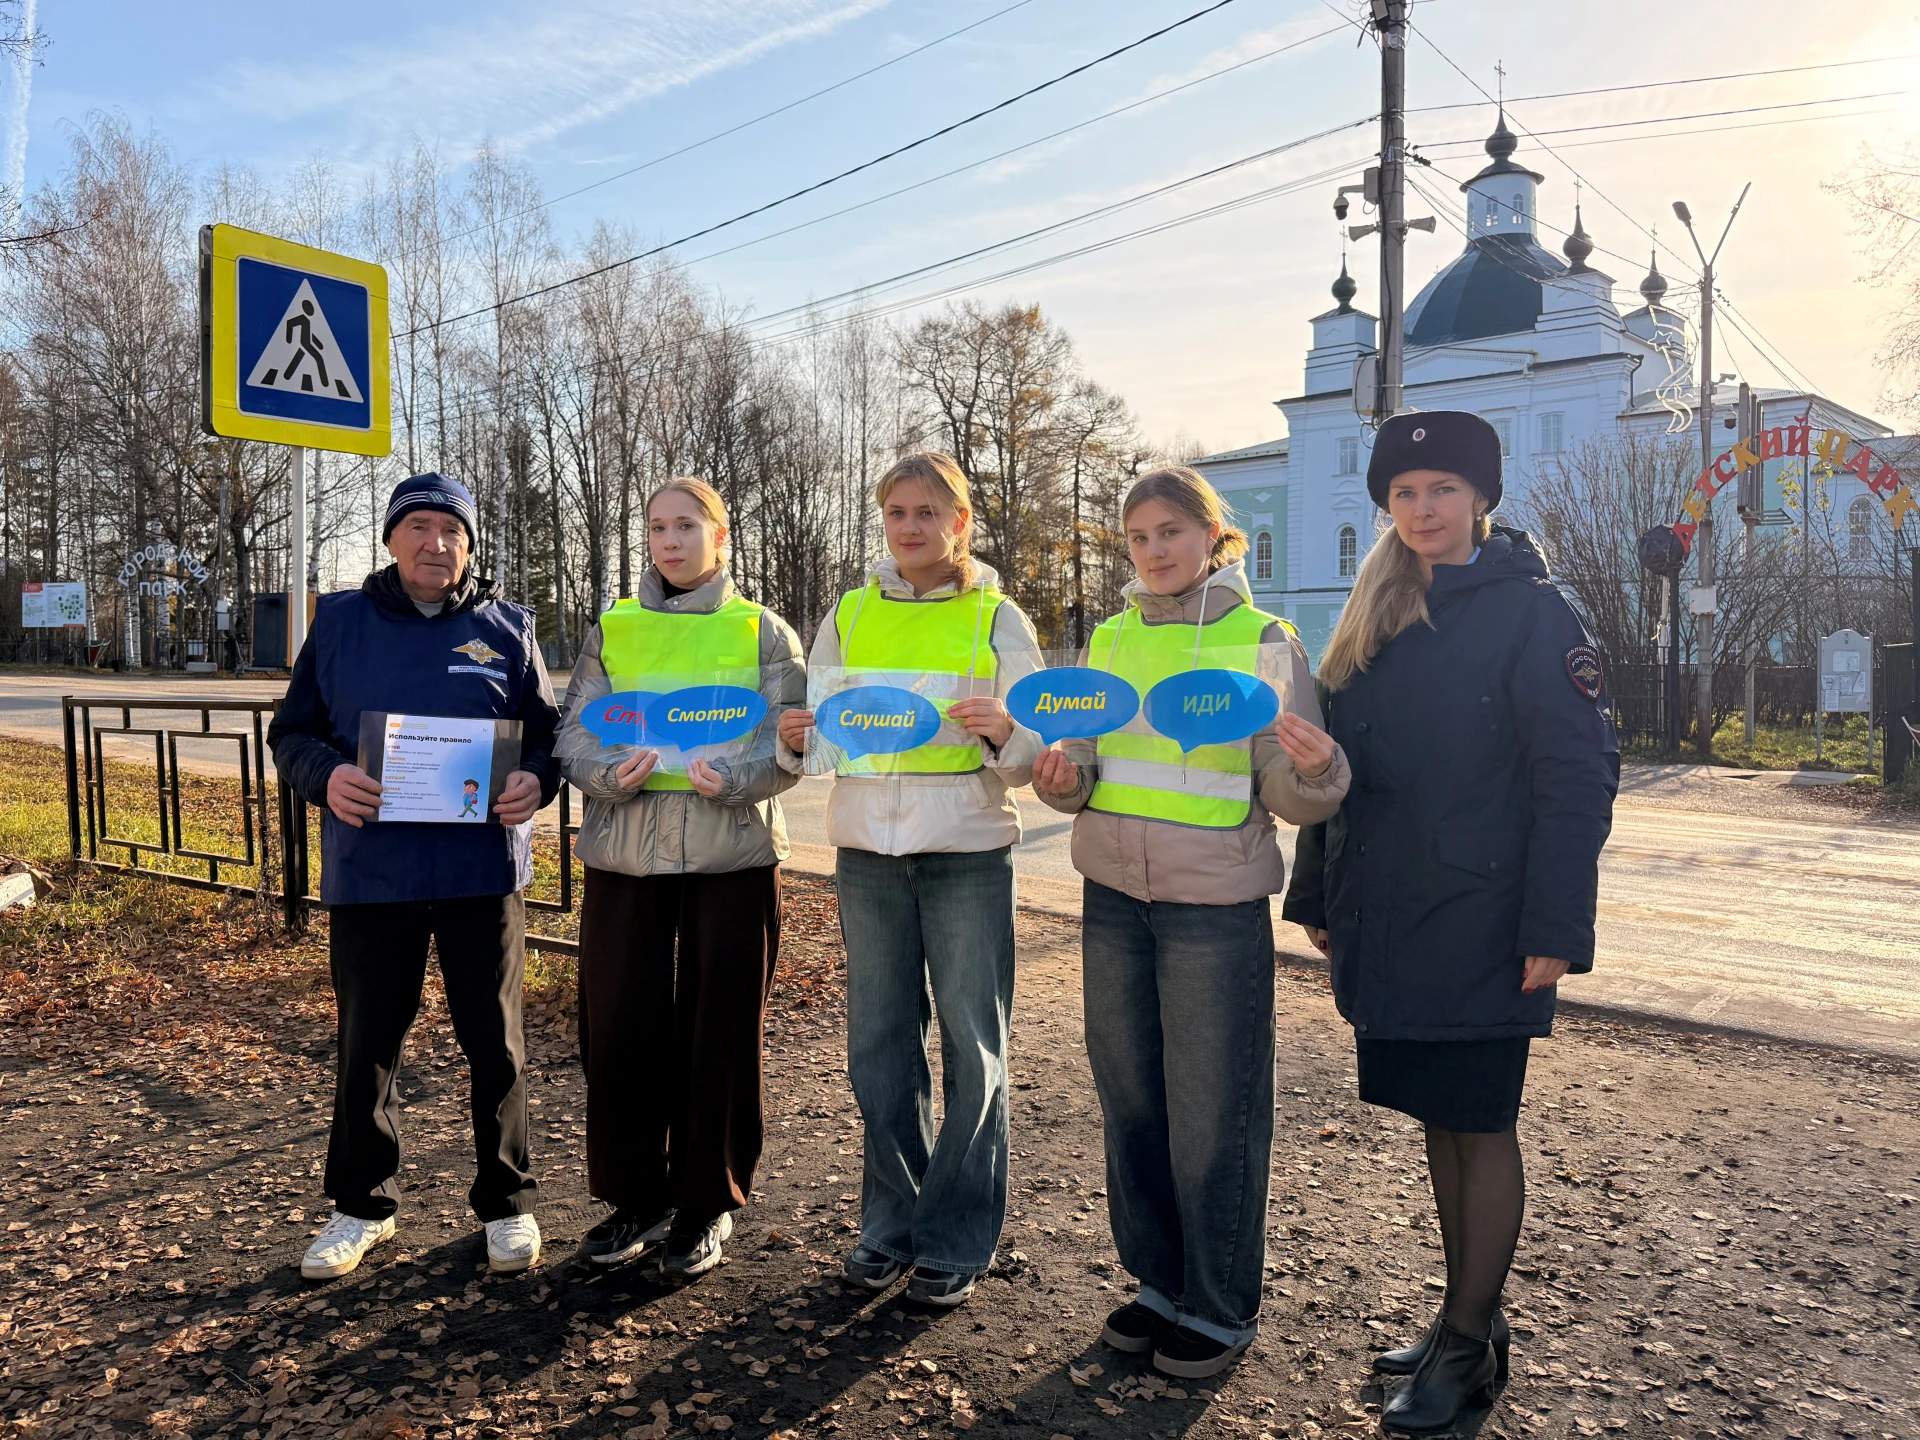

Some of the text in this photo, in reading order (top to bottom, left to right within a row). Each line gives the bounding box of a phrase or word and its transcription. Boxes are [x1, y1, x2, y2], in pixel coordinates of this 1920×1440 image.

[1820, 429, 1919, 530] ПАРК
[1034, 691, 1107, 714] Думай
[603, 704, 648, 727] Ст
[667, 705, 748, 724] Смотри
[839, 709, 916, 731] Слушай
[388, 733, 438, 742] Используйте
